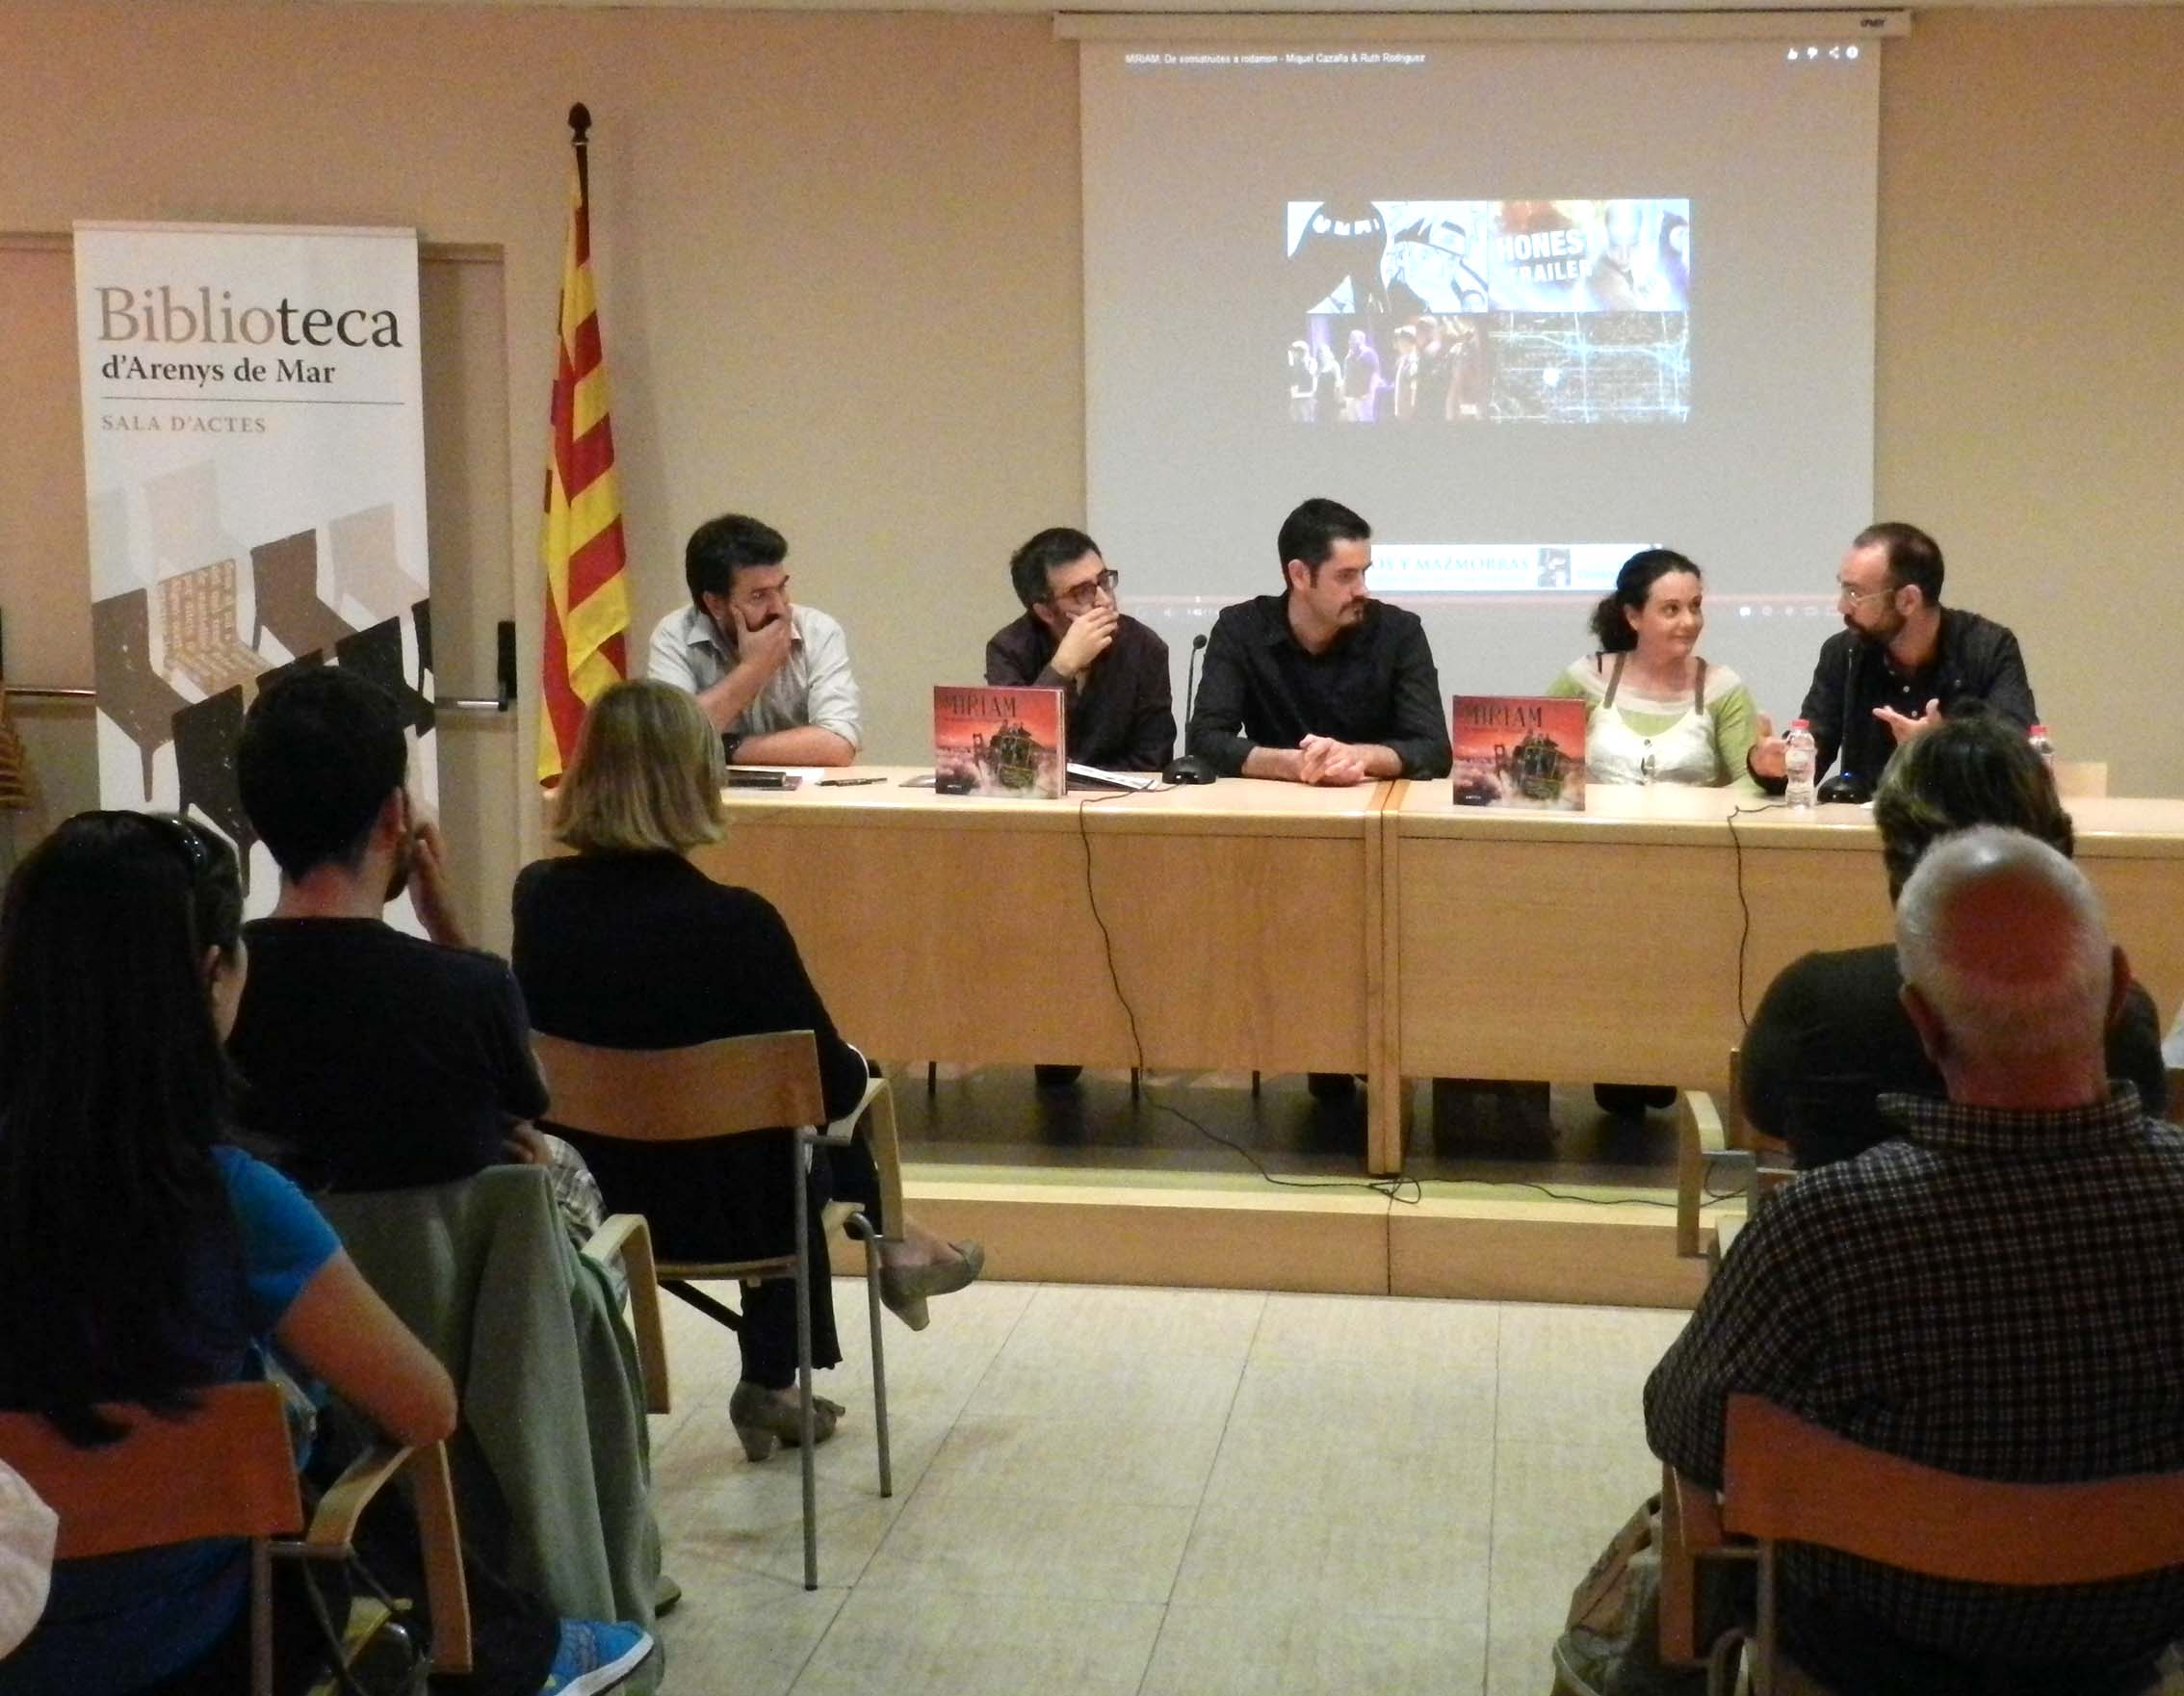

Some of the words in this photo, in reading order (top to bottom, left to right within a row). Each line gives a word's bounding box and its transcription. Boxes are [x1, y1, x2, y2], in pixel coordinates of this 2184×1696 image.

[1360, 53, 1381, 64] Ruth
[94, 285, 403, 348] Biblioteca
[101, 354, 224, 387] d'Arenys
[234, 357, 267, 382] de
[276, 358, 336, 384] Mar
[102, 415, 161, 432] SALA
[170, 416, 266, 433] D'ACTES
